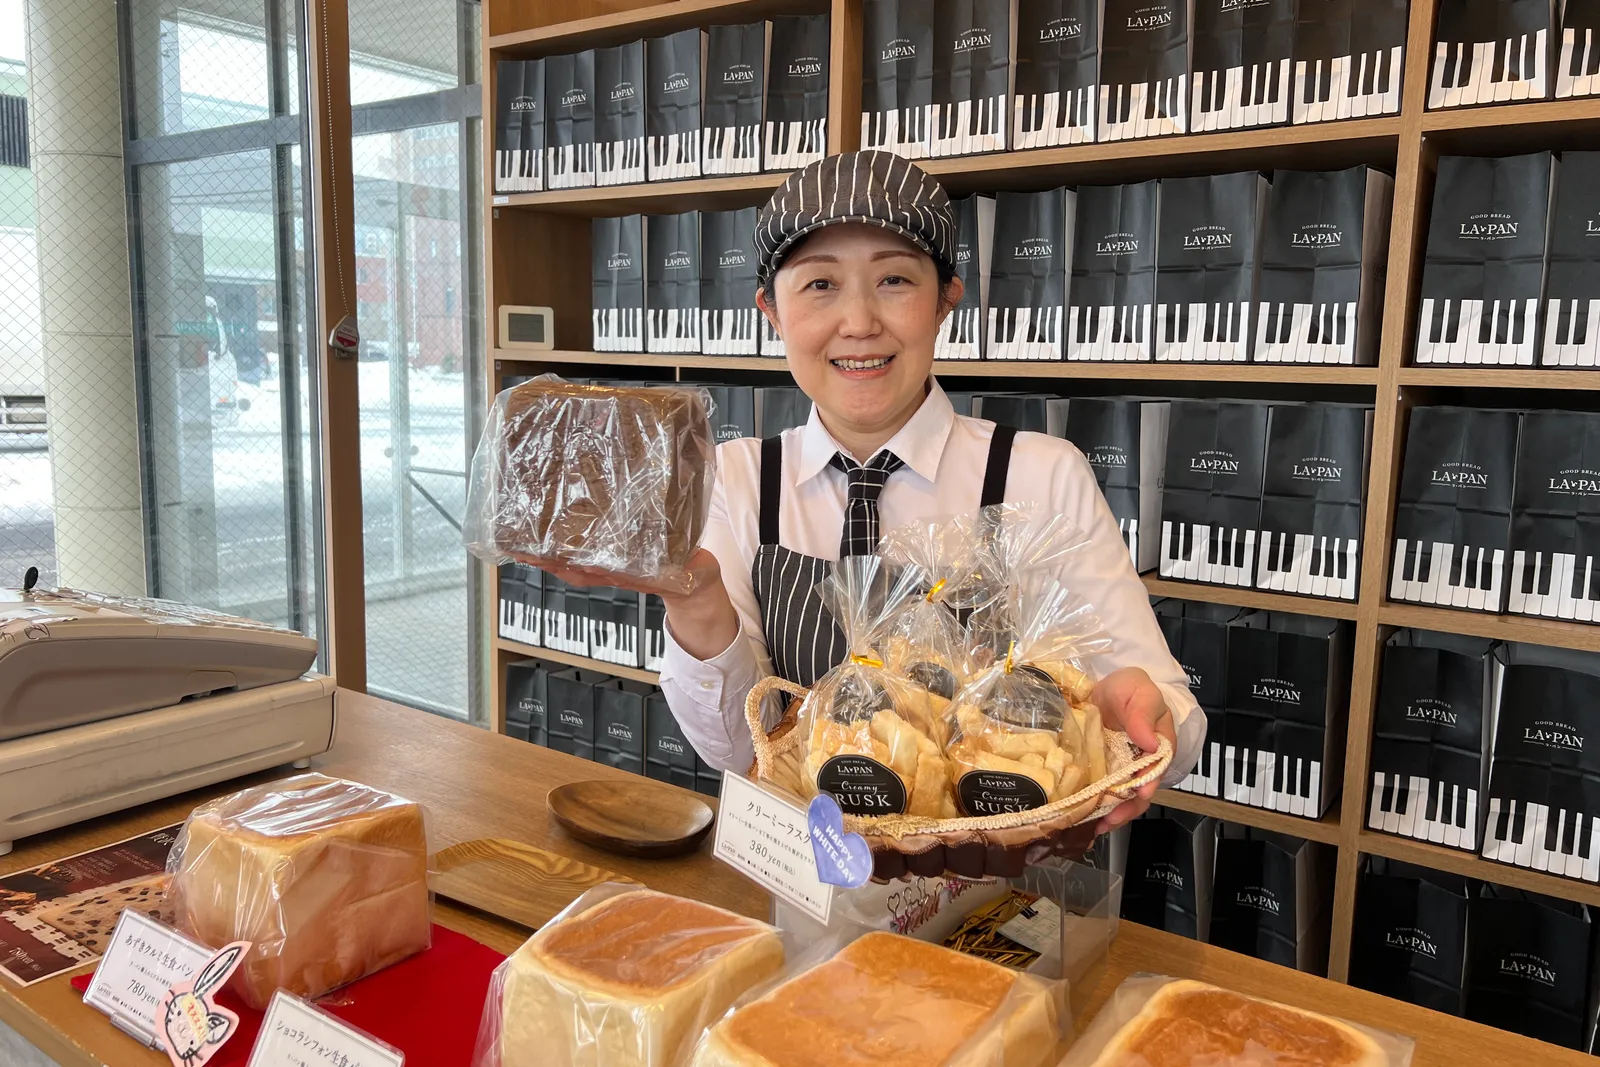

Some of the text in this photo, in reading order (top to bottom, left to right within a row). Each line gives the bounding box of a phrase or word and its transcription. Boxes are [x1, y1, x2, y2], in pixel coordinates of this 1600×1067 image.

[834, 792, 893, 807] RUSK
[841, 780, 878, 796] Creamy
[981, 791, 1020, 806] Creamy
[746, 801, 811, 844] クリーミーラスク
[749, 839, 768, 858] 380
[767, 853, 782, 867] yen
[812, 825, 855, 883] WHITE DAY
[825, 824, 854, 862] HAPPY
[127, 979, 145, 997] 780
[143, 992, 156, 1005] yen
